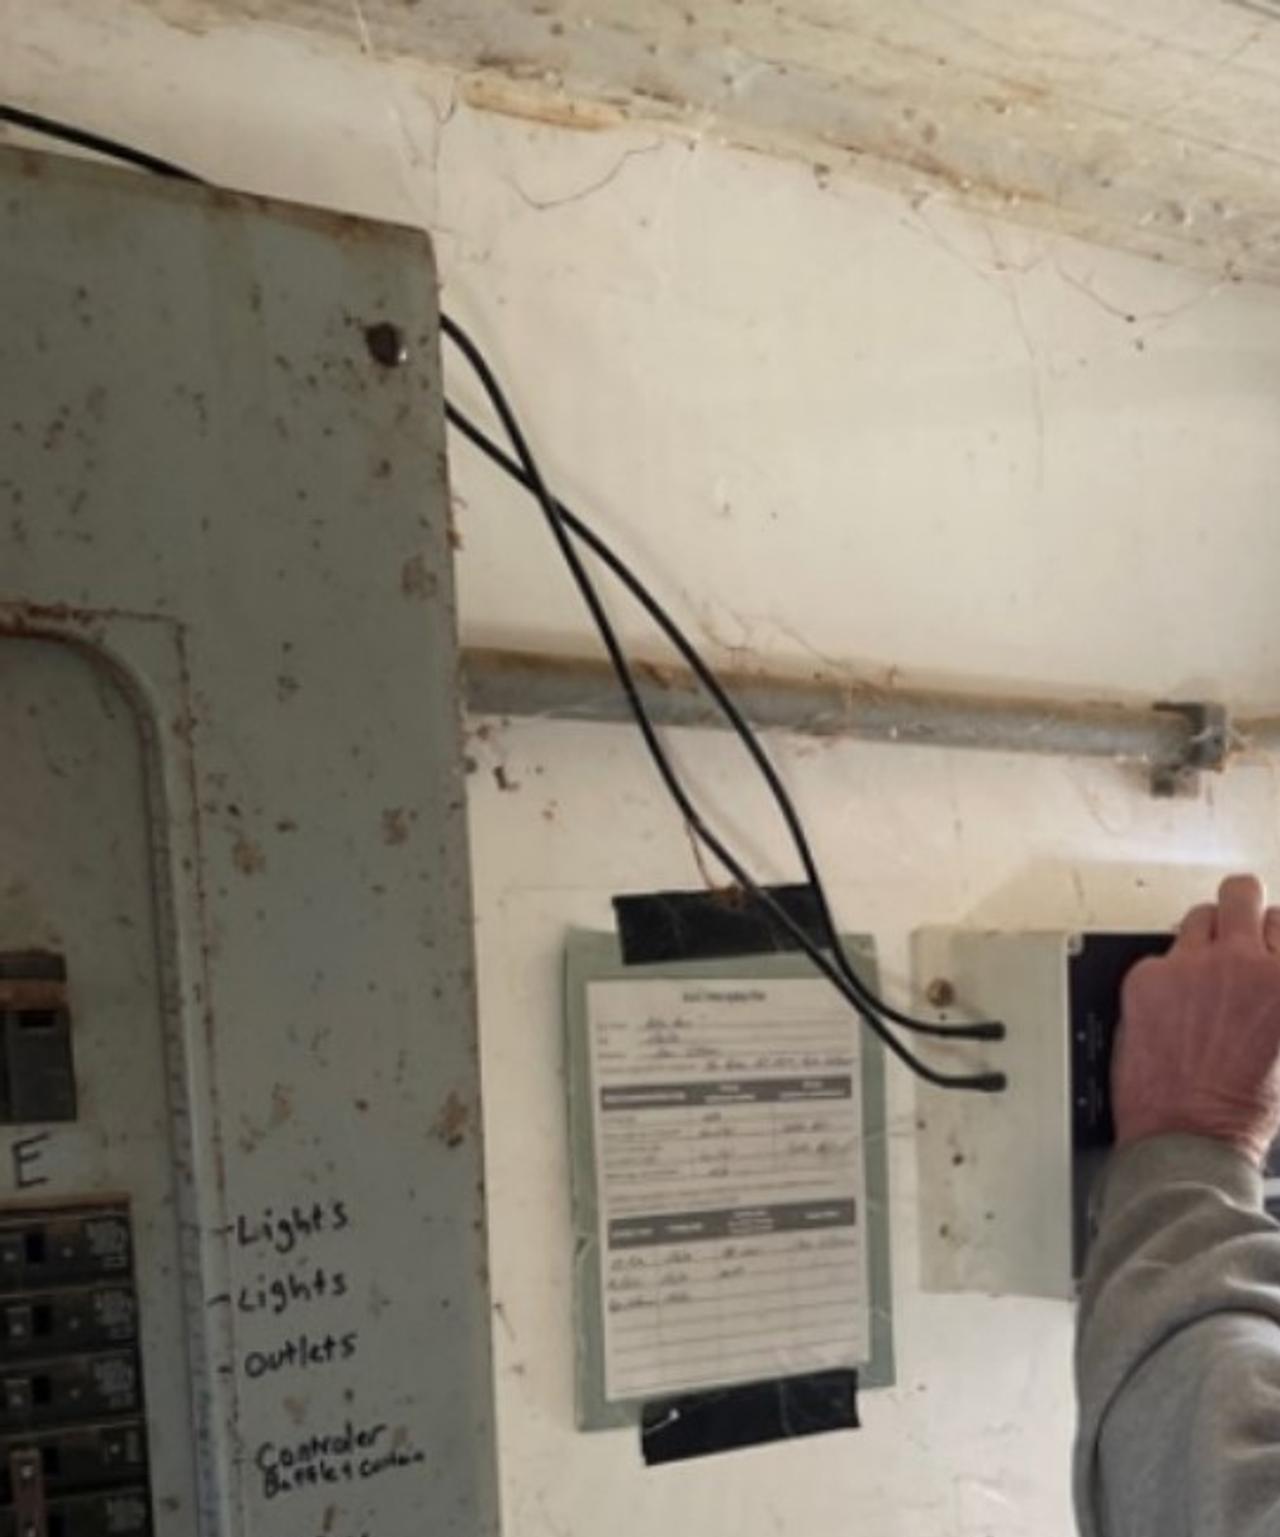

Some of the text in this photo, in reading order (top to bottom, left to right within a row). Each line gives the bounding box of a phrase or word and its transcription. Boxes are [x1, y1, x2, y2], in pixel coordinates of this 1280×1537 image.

[11, 1133, 50, 1190] E
[237, 1201, 350, 1254] Lights
[237, 1267, 348, 1315] Lights
